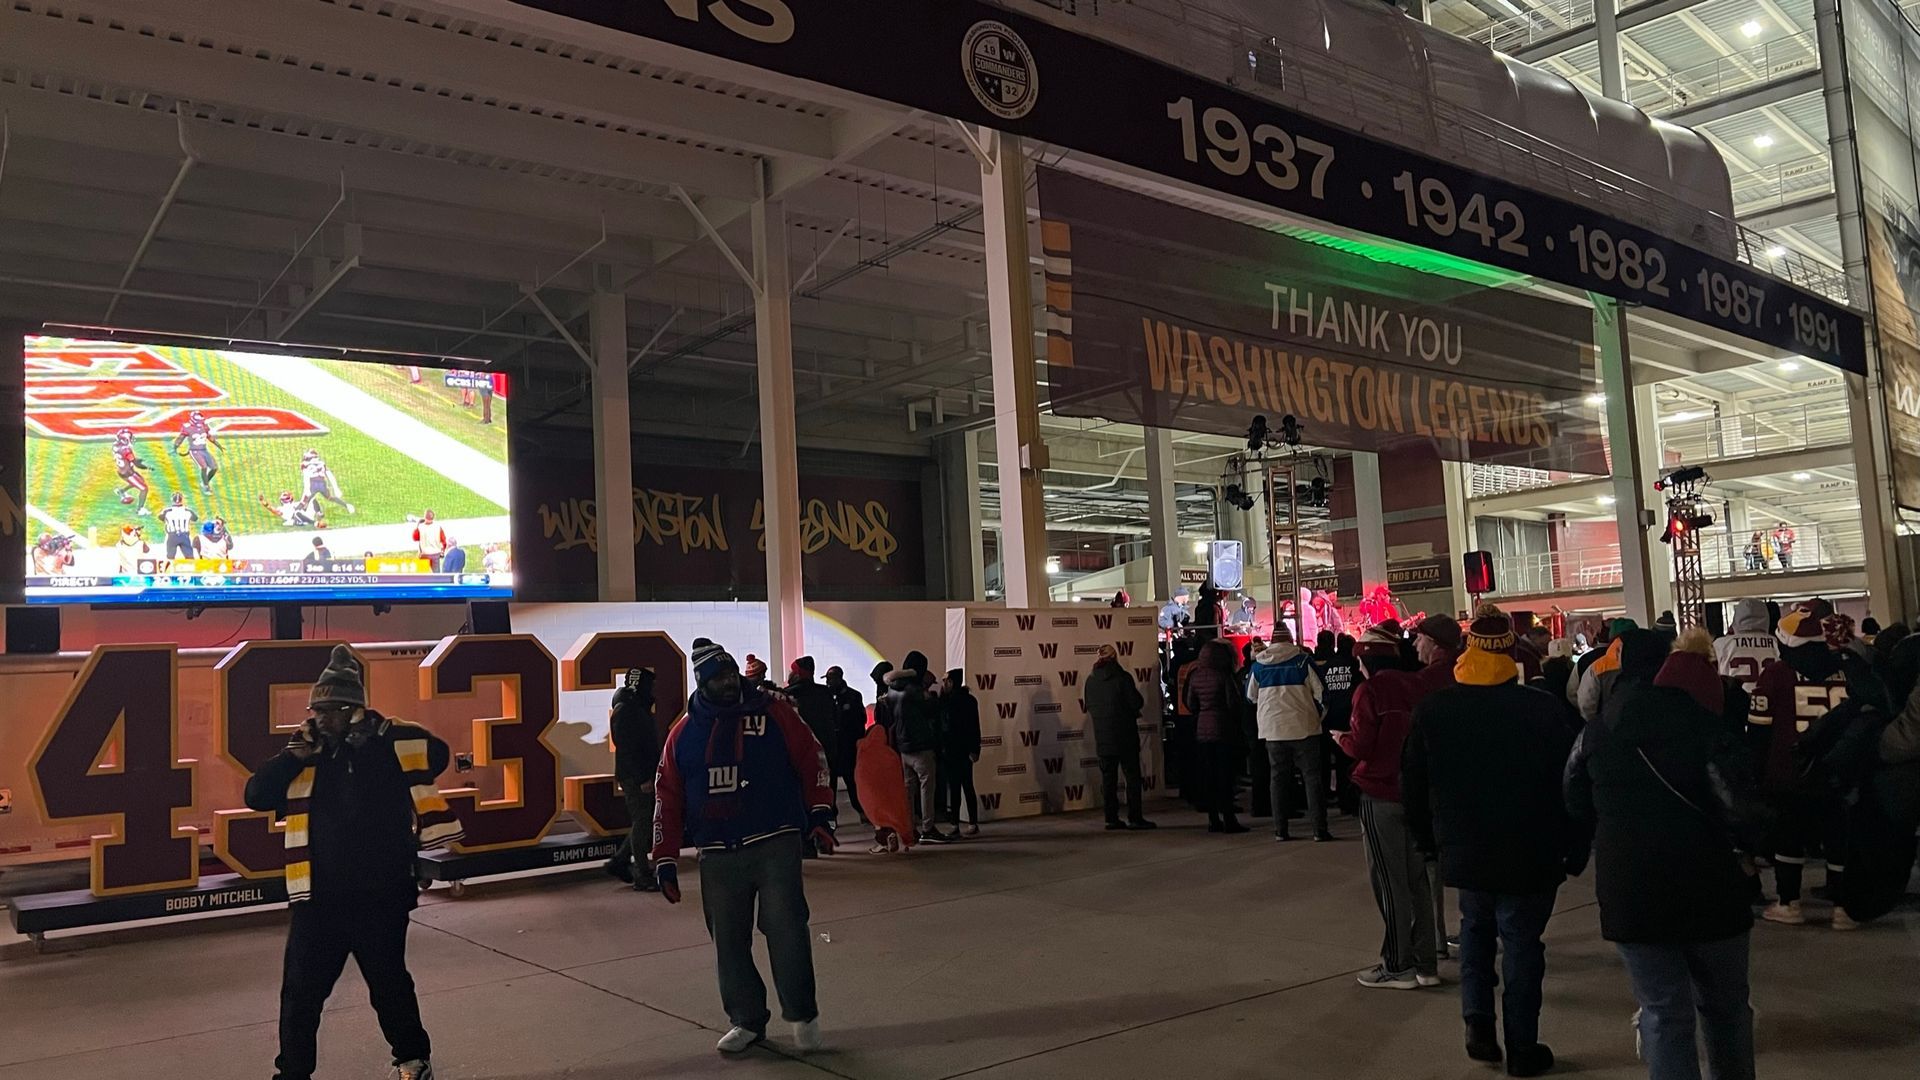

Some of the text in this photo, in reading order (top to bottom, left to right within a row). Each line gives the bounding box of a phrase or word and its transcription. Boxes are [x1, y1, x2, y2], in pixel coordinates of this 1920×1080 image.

[662, 0, 795, 43] S
[975, 57, 1026, 81] COMMANDERS
[1005, 85, 1018, 97] 32
[1166, 95, 1840, 356] 1937 1942 1982 1987 1991
[1264, 281, 1462, 365] THANK YOU
[1142, 316, 1551, 449] WASHINGTON LEGENDS
[537, 487, 730, 554] WASNGTON
[50, 575, 98, 587] DIRECTV
[248, 576, 269, 584] DET:
[330, 576, 346, 584] 252
[1180, 572, 1191, 581] ALL
[1387, 568, 1440, 582] ENDS PLAZA
[1314, 578, 1339, 589] PLAZA
[1016, 615, 1036, 630] W
[1094, 614, 1113, 629] W
[1039, 643, 1058, 659] W
[1116, 641, 1134, 656] W
[1735, 637, 1775, 649] TAYLOR
[1135, 668, 1152, 682] W
[1326, 665, 1352, 675] APEX
[976, 674, 996, 690] W
[1059, 671, 1078, 686] W
[1324, 674, 1353, 684] SECURITY
[1327, 681, 1352, 691] GROUP
[996, 702, 1017, 719] W
[1020, 730, 1040, 747] W
[1043, 757, 1064, 774] W
[708, 765, 738, 795] ny
[1065, 785, 1084, 801] W
[980, 794, 1002, 810] W
[553, 843, 617, 862] SAMMY BAUGH
[165, 888, 264, 911] BOBBY MITCHELL
